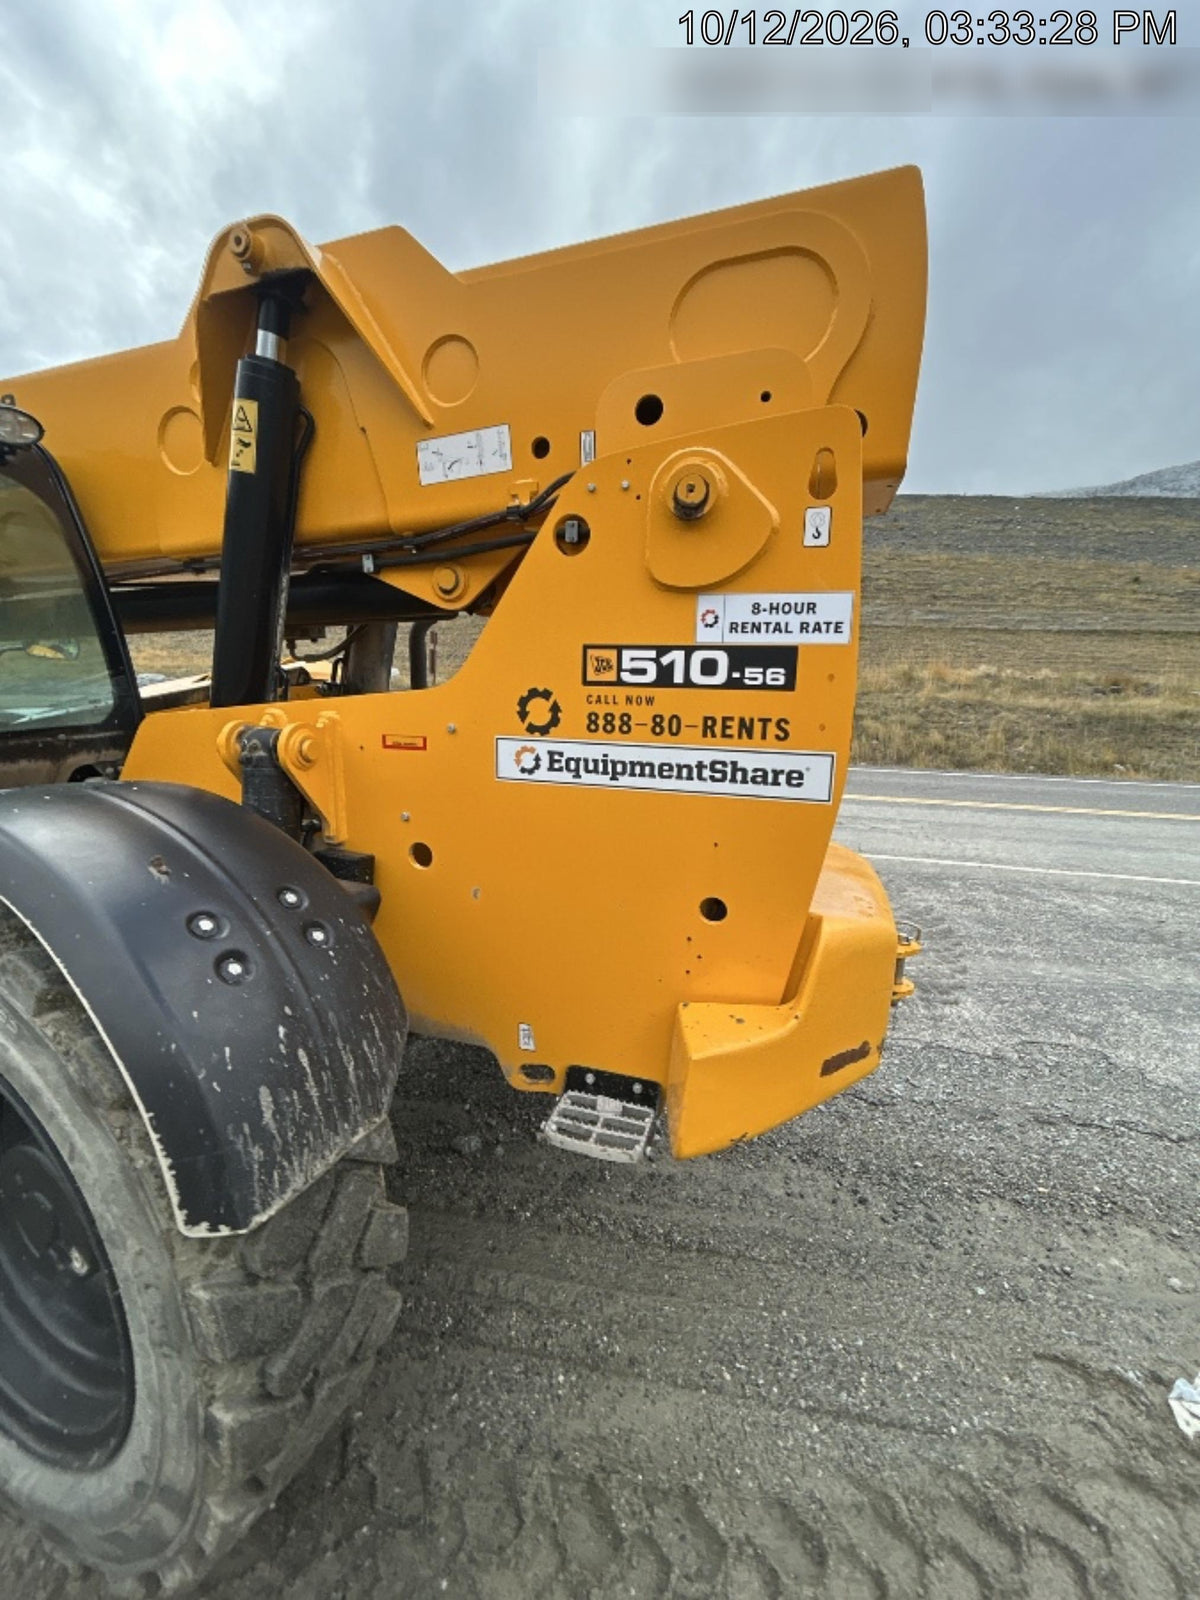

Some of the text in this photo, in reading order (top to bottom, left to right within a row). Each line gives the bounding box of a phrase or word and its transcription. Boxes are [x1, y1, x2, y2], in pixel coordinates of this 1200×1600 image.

[750, 601, 818, 616] 8-HOUR
[728, 621, 845, 635] RENTAL RATE
[586, 694, 656, 707] CALL NOW
[586, 712, 791, 742] 888-80-RENTS
[546, 750, 806, 789] EquipmentShare
